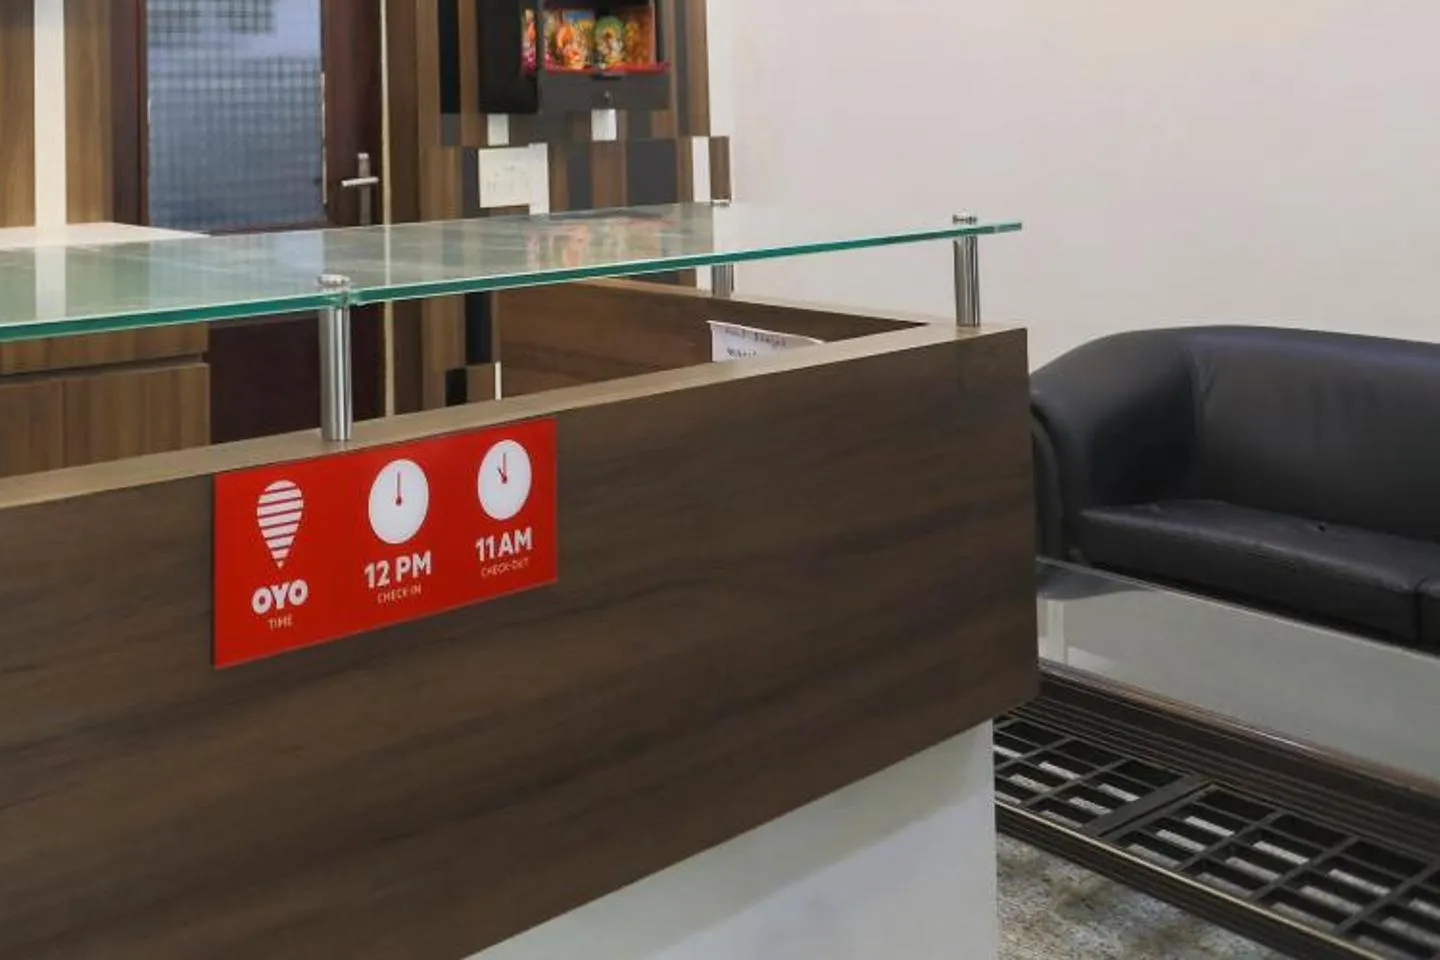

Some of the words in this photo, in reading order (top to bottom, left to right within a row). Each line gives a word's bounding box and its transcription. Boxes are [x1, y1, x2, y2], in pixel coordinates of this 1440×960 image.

[364, 561, 391, 589] 12
[395, 550, 432, 582] PM
[251, 578, 309, 615] OYO
